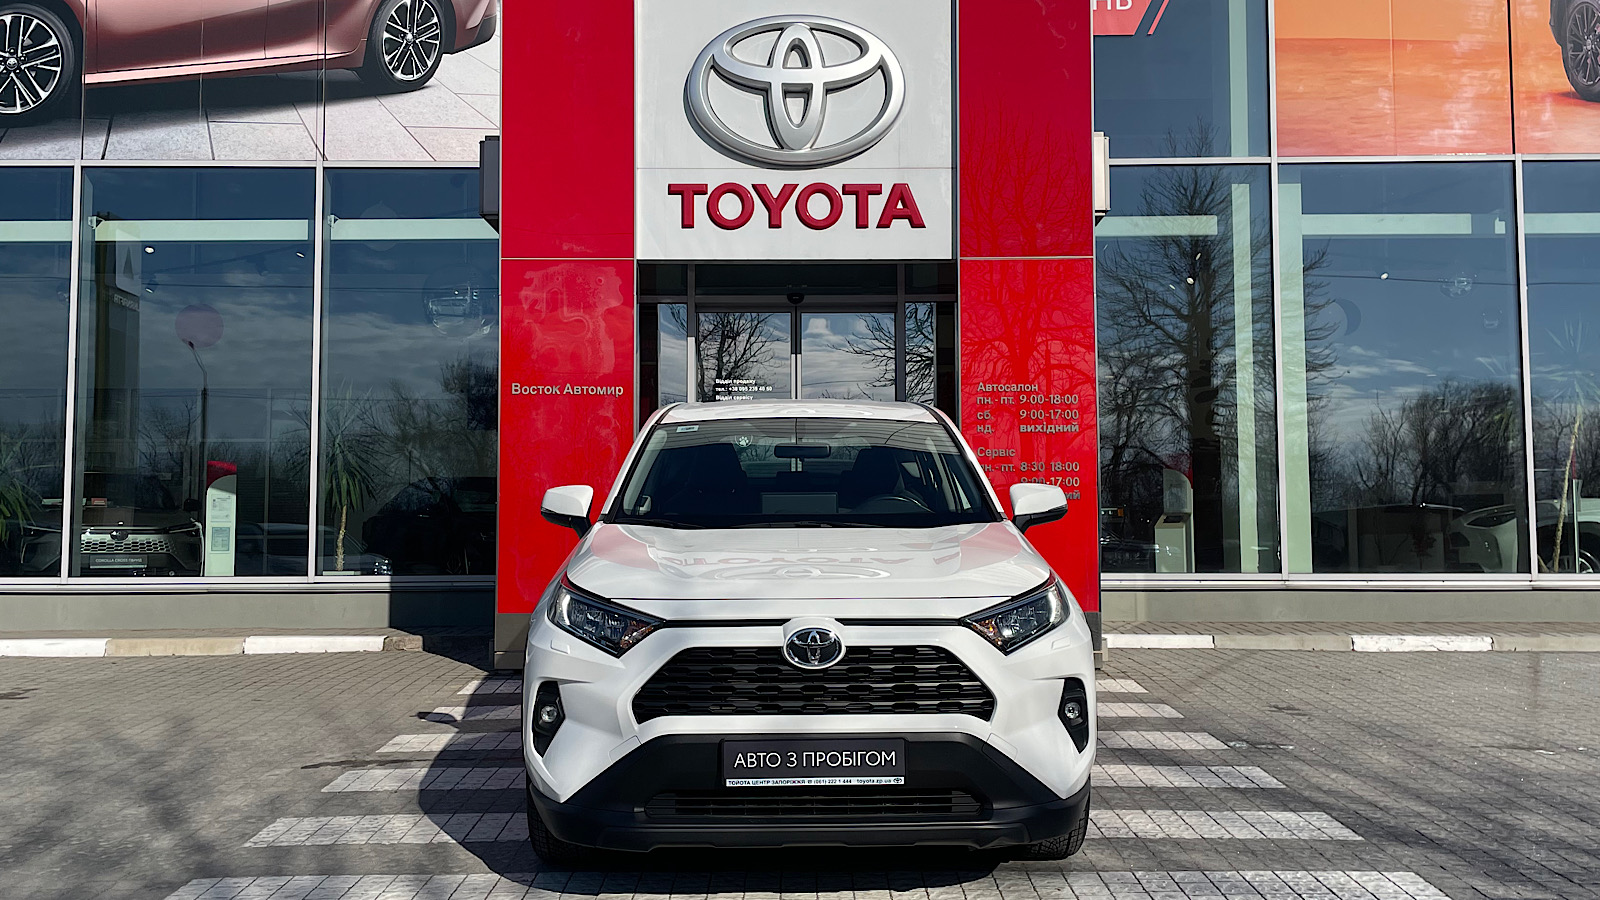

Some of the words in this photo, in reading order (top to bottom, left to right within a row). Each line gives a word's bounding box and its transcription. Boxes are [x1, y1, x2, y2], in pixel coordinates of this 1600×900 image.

[668, 182, 926, 230] TOYOTA
[511, 382, 561, 395] Восток
[563, 383, 624, 397] Автомир
[977, 382, 1038, 392] Автосалон
[976, 396, 993, 405] пн.
[1000, 396, 1015, 405] пт.
[977, 410, 993, 419] сб.
[1019, 409, 1080, 420] 9:00-17:00
[976, 424, 994, 434] нд.
[1019, 422, 1080, 434] вихідний
[977, 447, 1016, 458] Сервіс
[982, 464, 994, 472] н.
[1001, 463, 1016, 472] пт.
[734, 752, 782, 768] АВТО
[786, 752, 798, 767] З
[802, 751, 897, 768] ПРОБІГОМ
